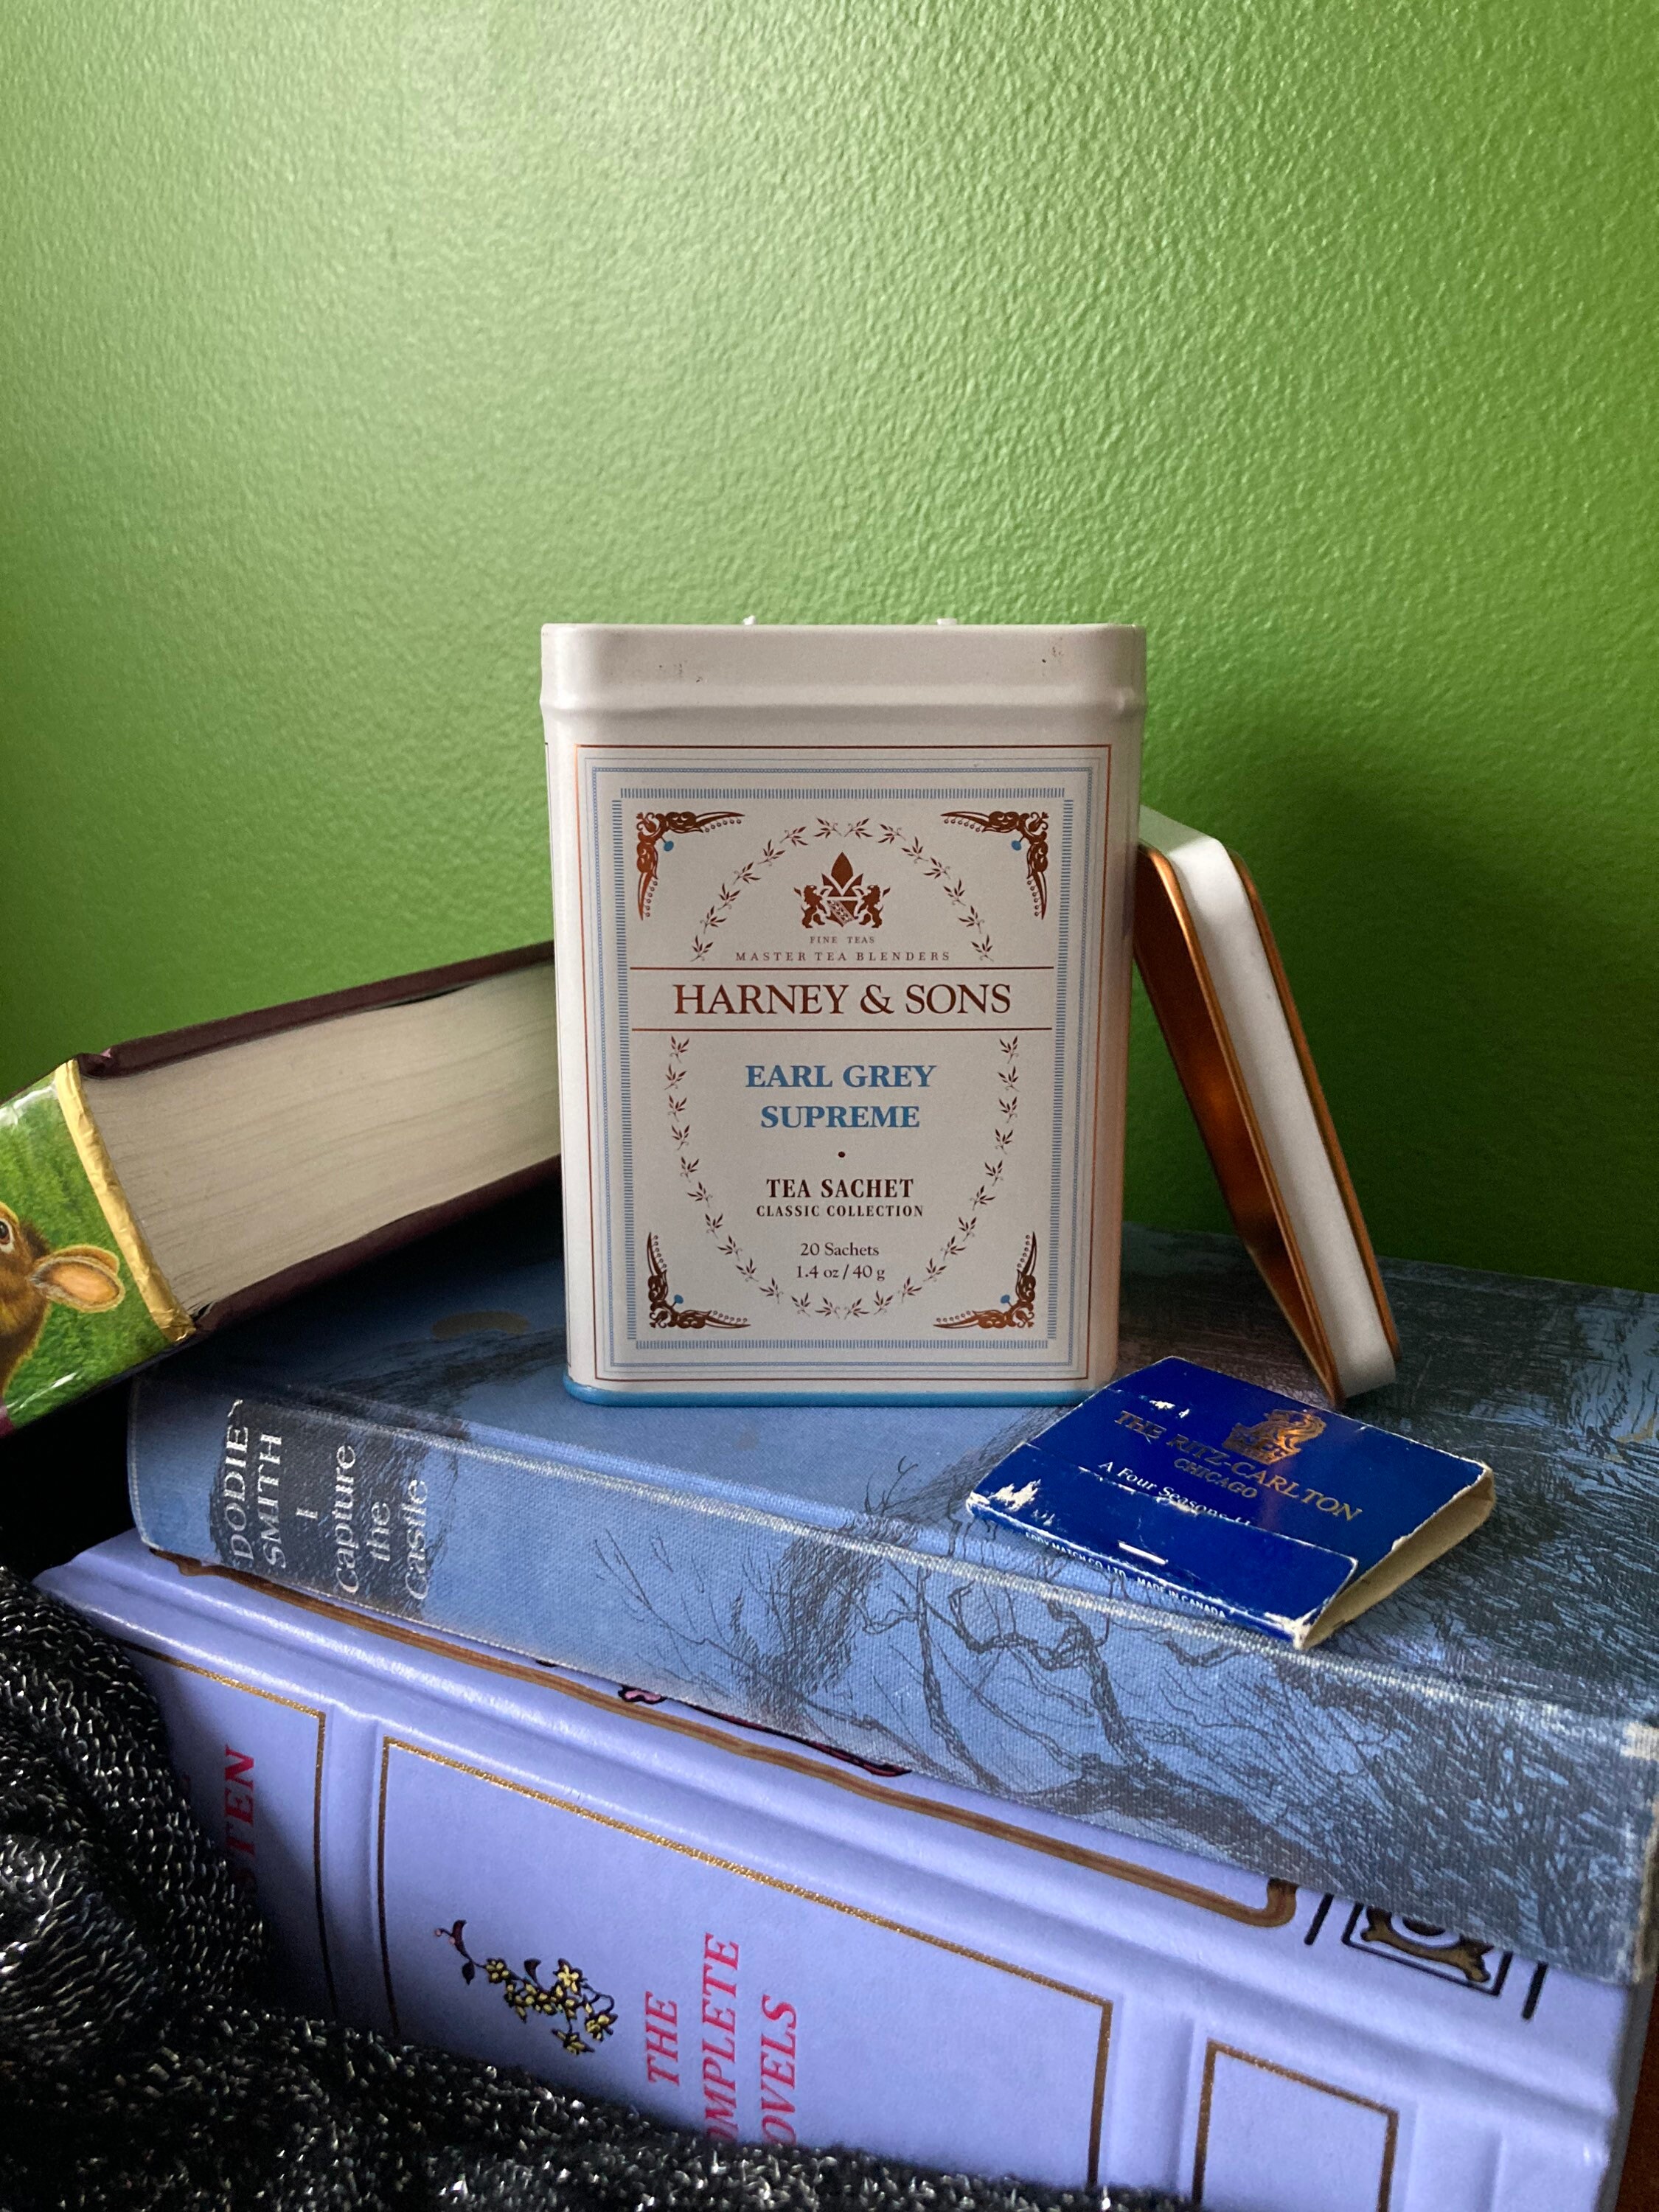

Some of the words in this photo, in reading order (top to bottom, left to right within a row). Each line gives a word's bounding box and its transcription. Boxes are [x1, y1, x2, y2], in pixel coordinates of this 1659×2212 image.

[736, 952, 806, 961] MASTER
[815, 952, 846, 961] TEA
[857, 952, 950, 961] BLENDERS
[674, 984, 848, 1015] HARNEY
[860, 984, 894, 1015] &
[905, 984, 1011, 1015] SONS
[745, 1065, 832, 1088] EARL
[843, 1064, 937, 1088] GREY
[760, 1105, 920, 1128] SUPREME
[766, 1178, 811, 1198] TEA
[821, 1178, 914, 1198] SACHET
[757, 1205, 820, 1217] CLASSIC
[827, 1205, 923, 1217] COLLECTION
[800, 1242, 820, 1256] 20
[824, 1242, 880, 1256] Sachets
[796, 1265, 819, 1279] 1.4
[1098, 1461, 1113, 1473] A
[1117, 1467, 1158, 1491] Four
[1114, 1410, 1167, 1439] THE
[1166, 1433, 1363, 1521] RITZ-CARLTON
[1173, 1458, 1258, 1499] CHICAGO
[223, 1426, 254, 1561] DODIE
[257, 1433, 286, 1568] SMITH
[366, 1501, 391, 1562] the
[1137, 1576, 1165, 1594] MADE
[1169, 1588, 1179, 1599] IN
[1181, 1595, 1226, 1618] CANADA
[644, 1991, 680, 2087] THE
[760, 1994, 797, 2146] OVELS
